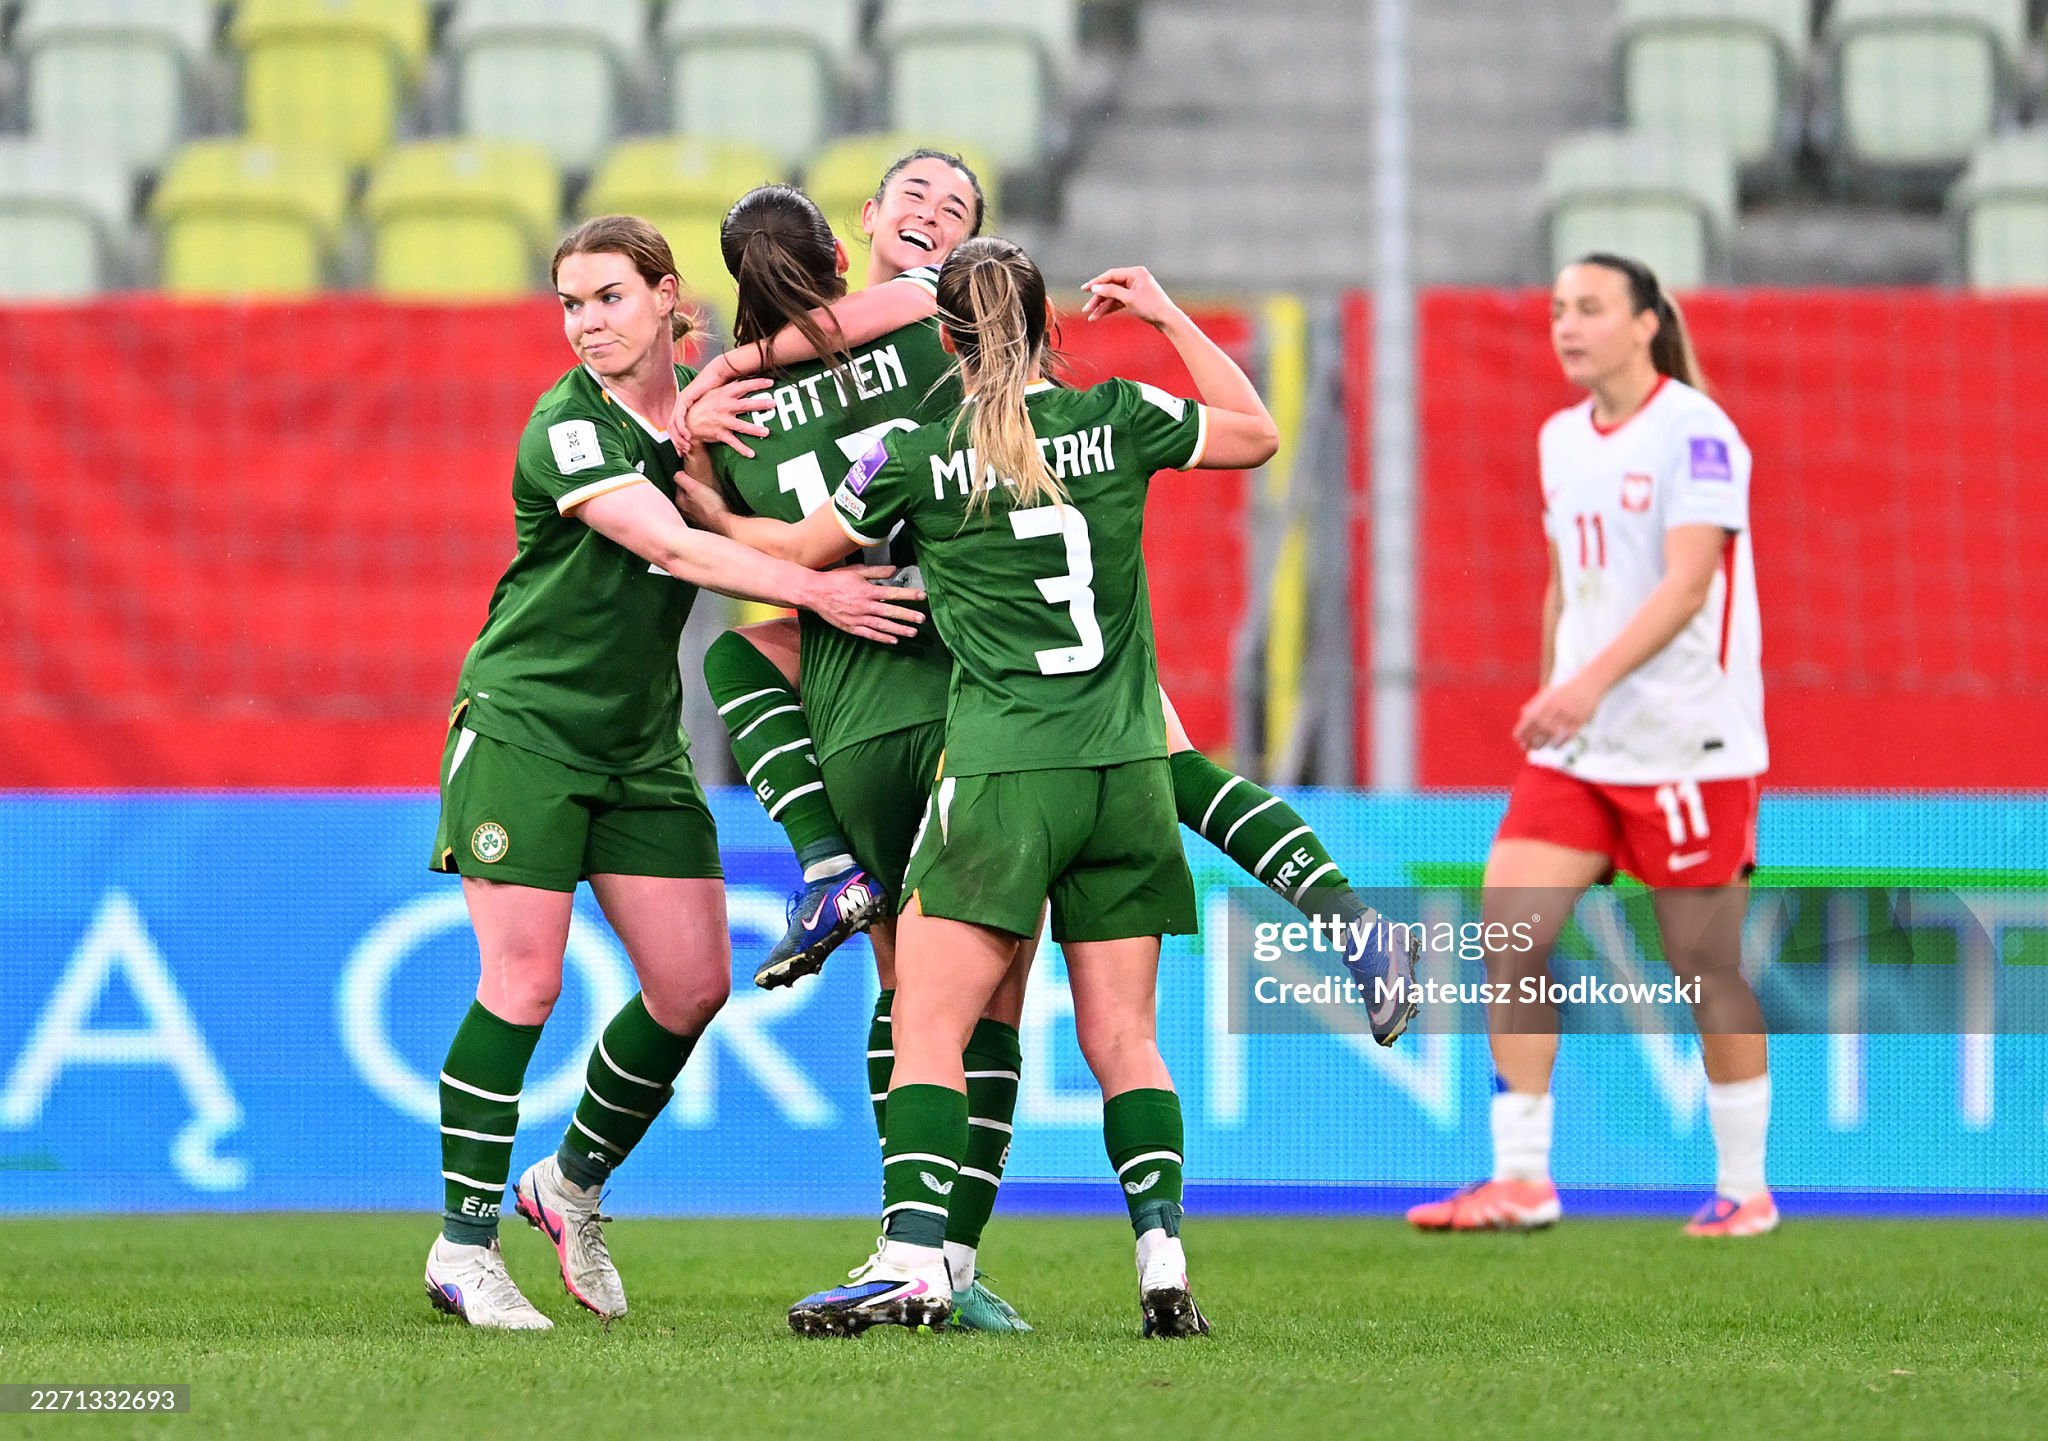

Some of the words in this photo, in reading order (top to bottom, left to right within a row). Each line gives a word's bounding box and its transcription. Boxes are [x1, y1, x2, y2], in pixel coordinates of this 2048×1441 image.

[750, 344, 907, 431] PATTEN
[1574, 512, 1606, 568] 11
[1008, 504, 1104, 675] 3
[1655, 780, 1710, 845] 11
[1266, 846, 1315, 896] IRE
[336, 884, 1462, 1132] OREN
